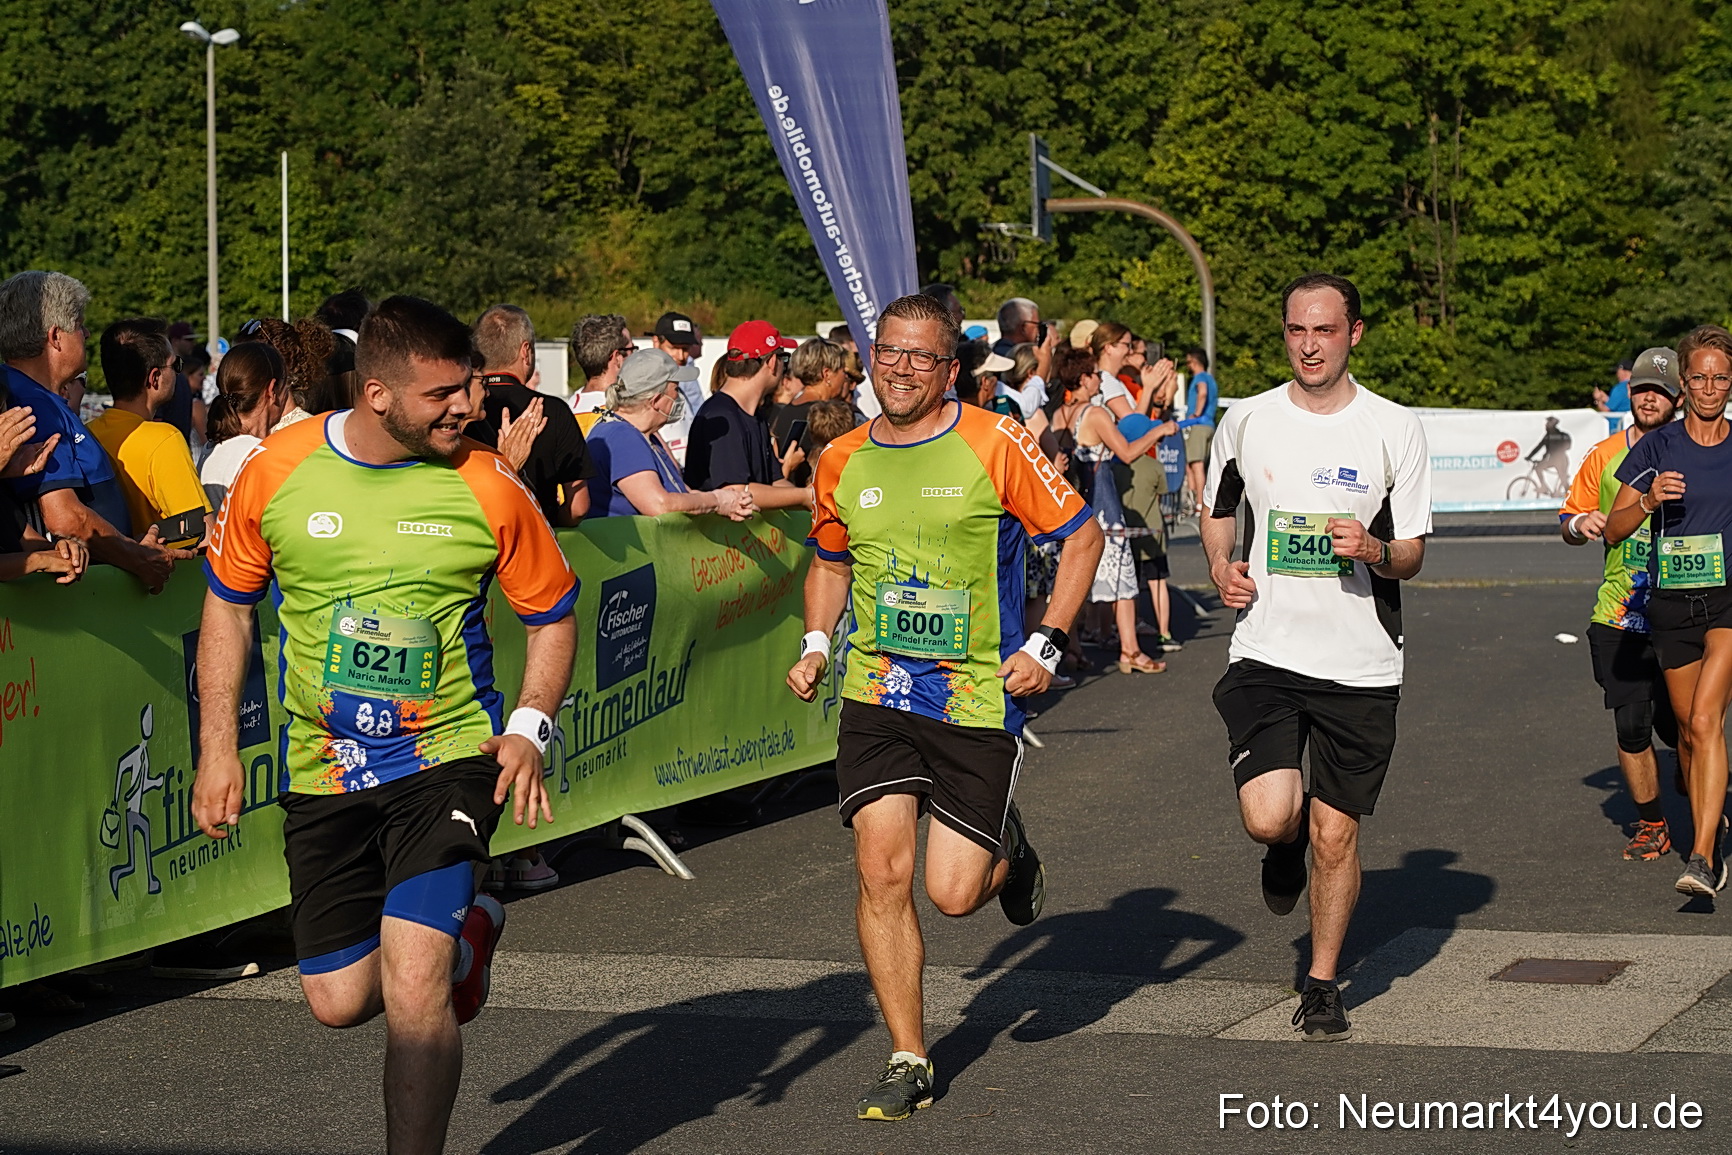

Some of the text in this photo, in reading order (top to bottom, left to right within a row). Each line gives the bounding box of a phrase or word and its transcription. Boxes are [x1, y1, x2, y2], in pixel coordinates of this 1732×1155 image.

[995, 415, 1075, 509] BOCK
[921, 486, 964, 498] BOCK
[1331, 478, 1370, 491] Firmenlauf
[397, 521, 454, 538] BOCK
[1271, 538, 1280, 561] RUN
[1287, 534, 1332, 556] 540
[1636, 541, 1653, 557] 62
[691, 535, 746, 593] Gesunde
[1282, 556, 1316, 565] Aurbach
[1661, 560, 1669, 579] RUN
[1672, 553, 1706, 572] 959
[1713, 555, 1722, 579] 2022
[607, 603, 649, 631] Fischer
[880, 613, 889, 638] RUN
[897, 610, 944, 636] 600
[356, 627, 392, 638] Firmenlauf
[610, 621, 643, 641] AUTOMOBILE
[892, 632, 948, 647] Pfindel Frank
[953, 617, 964, 650] 2022
[329, 643, 343, 674] RUN
[352, 641, 408, 674] 621
[347, 668, 411, 686] Naric Marko
[420, 651, 433, 689] 2022
[573, 639, 697, 753] firmenlauf
[576, 737, 627, 782] neumarkt
[169, 824, 243, 881] neumarkt
